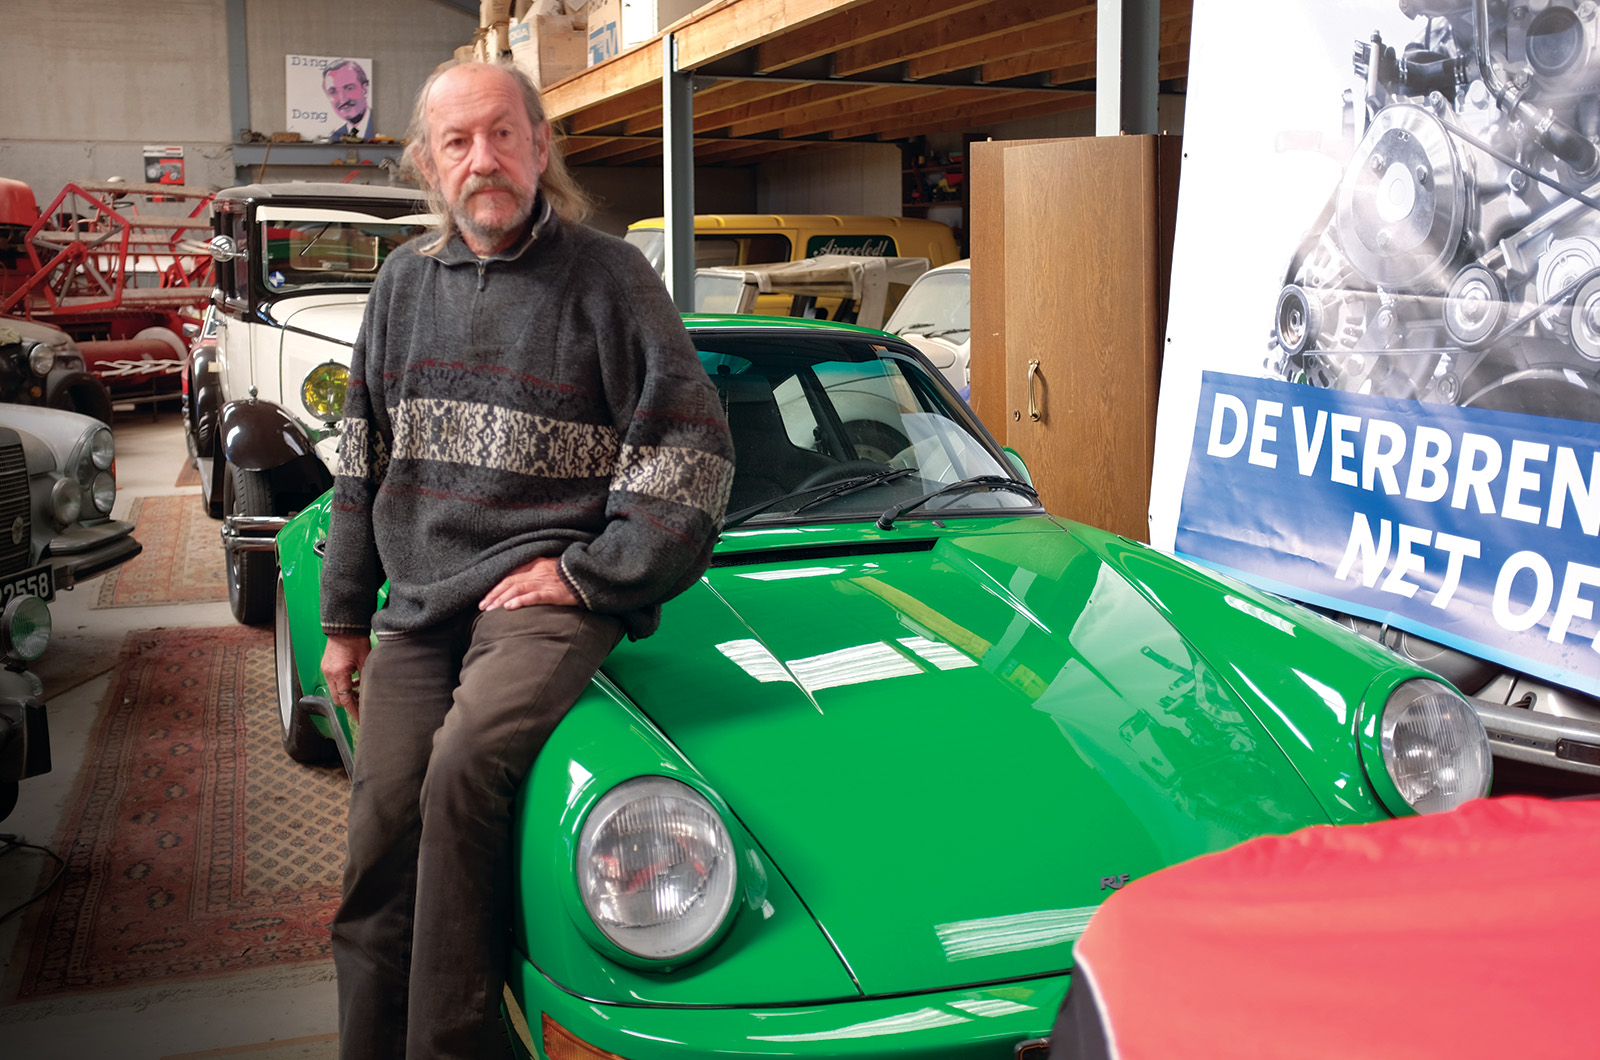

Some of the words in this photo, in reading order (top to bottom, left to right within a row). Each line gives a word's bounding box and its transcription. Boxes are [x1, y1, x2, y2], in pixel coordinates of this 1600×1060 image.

[291, 56, 328, 71] Ding
[292, 109, 328, 123] Dong
[813, 239, 888, 257] Aircooled!
[1207, 393, 1283, 469] DE
[1292, 406, 1600, 537] VERBREN
[1335, 512, 1481, 610] NET
[1492, 550, 1600, 655] OF
[0, 573, 49, 613] 2558
[1100, 873, 1130, 890] RUF
